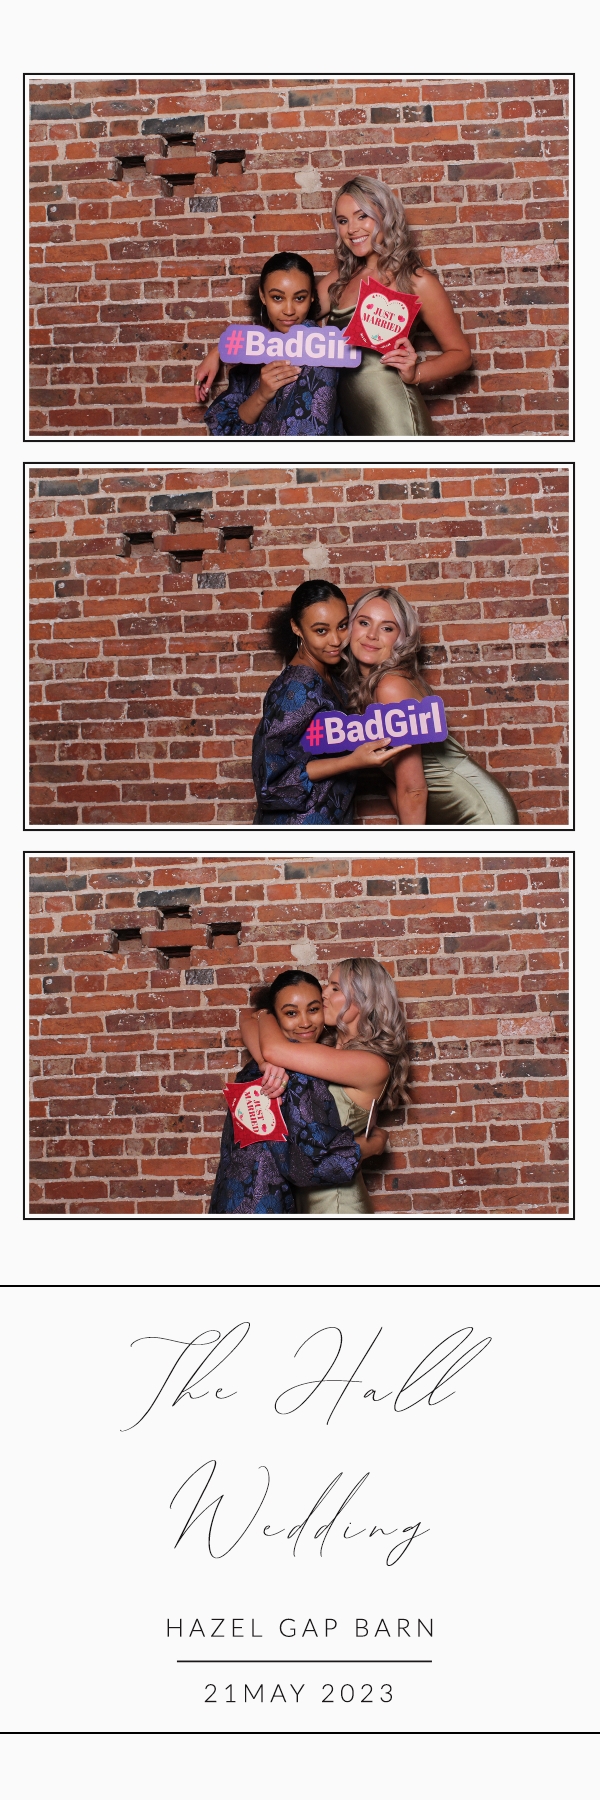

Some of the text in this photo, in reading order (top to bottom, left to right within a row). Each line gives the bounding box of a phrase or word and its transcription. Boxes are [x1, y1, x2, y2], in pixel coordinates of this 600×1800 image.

[362, 312, 402, 333] MARRIED
[373, 307, 396, 321] JUST
[306, 702, 442, 746] #BadGirl
[244, 1091, 259, 1133] MARRIED
[253, 1099, 265, 1121] JUST
